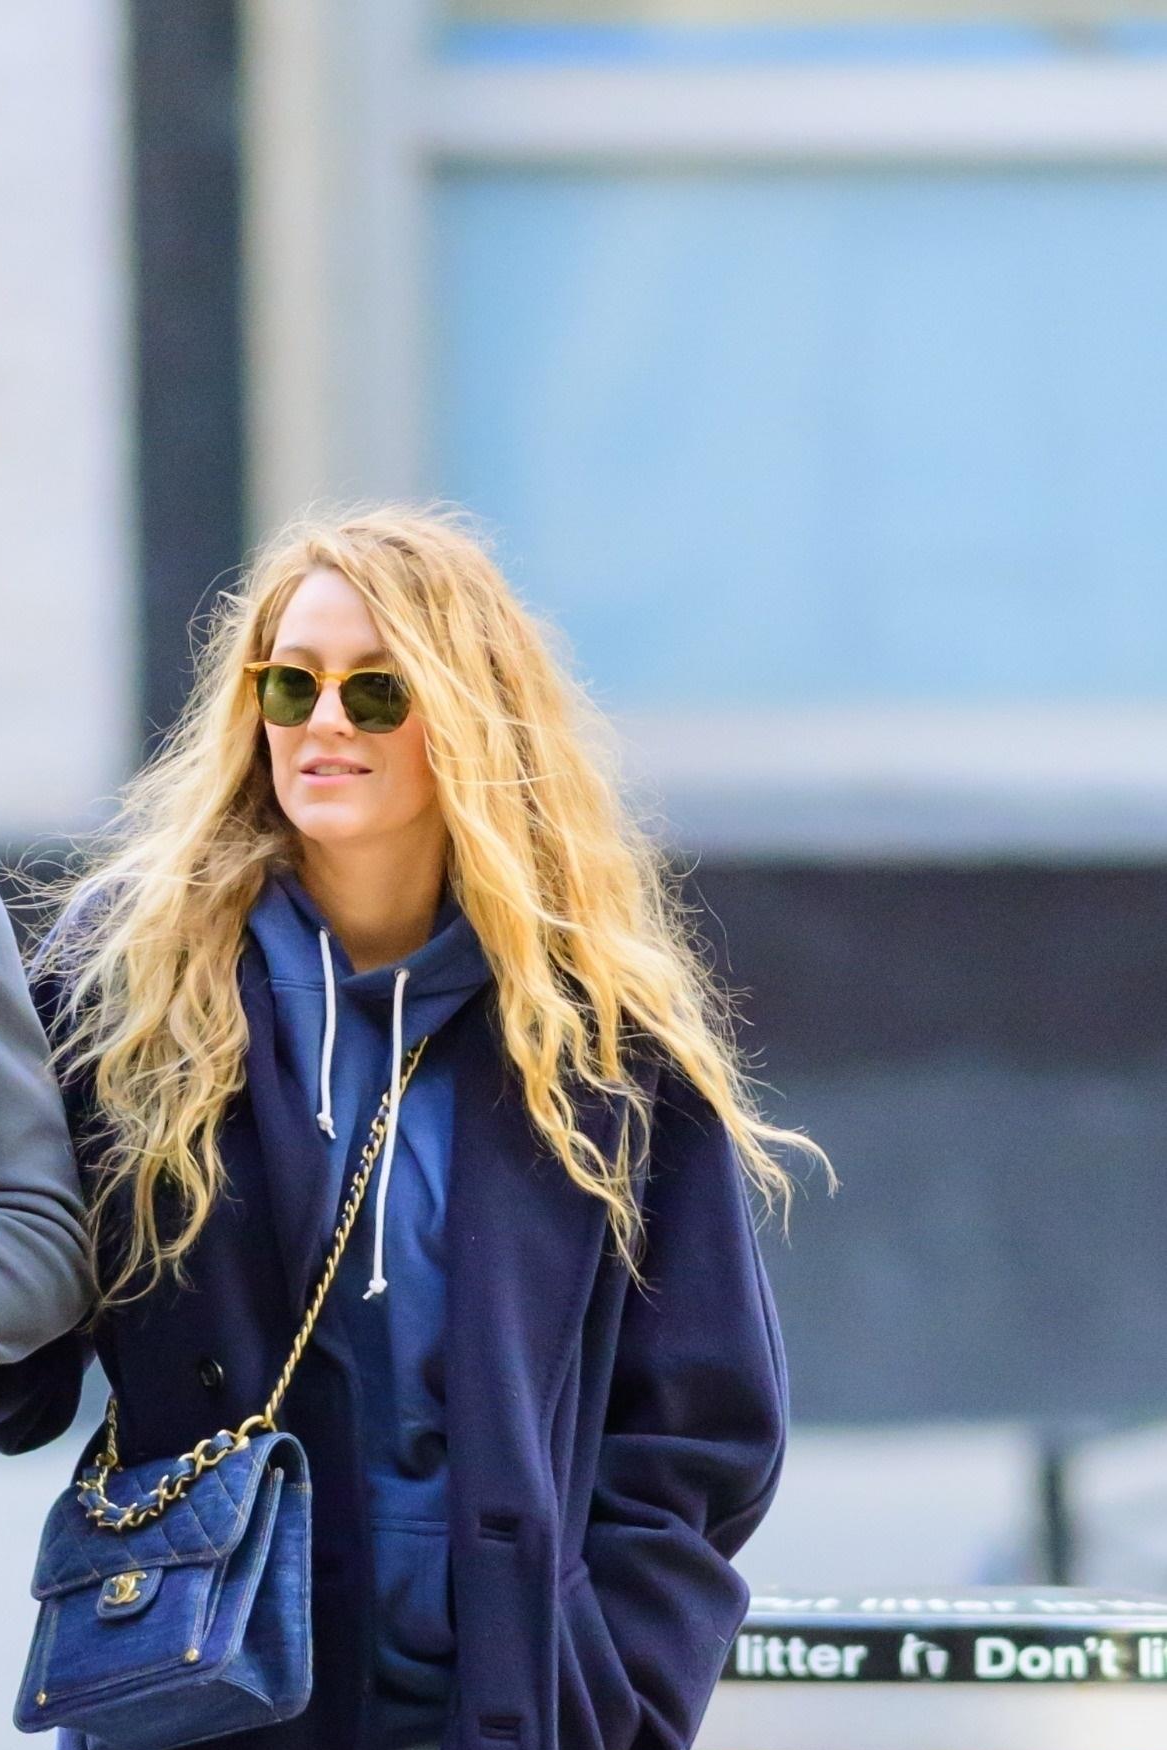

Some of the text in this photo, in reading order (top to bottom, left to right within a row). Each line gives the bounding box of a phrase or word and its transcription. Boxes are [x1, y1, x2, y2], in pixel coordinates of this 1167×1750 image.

[736, 1634, 1167, 1679] litter Don't li
